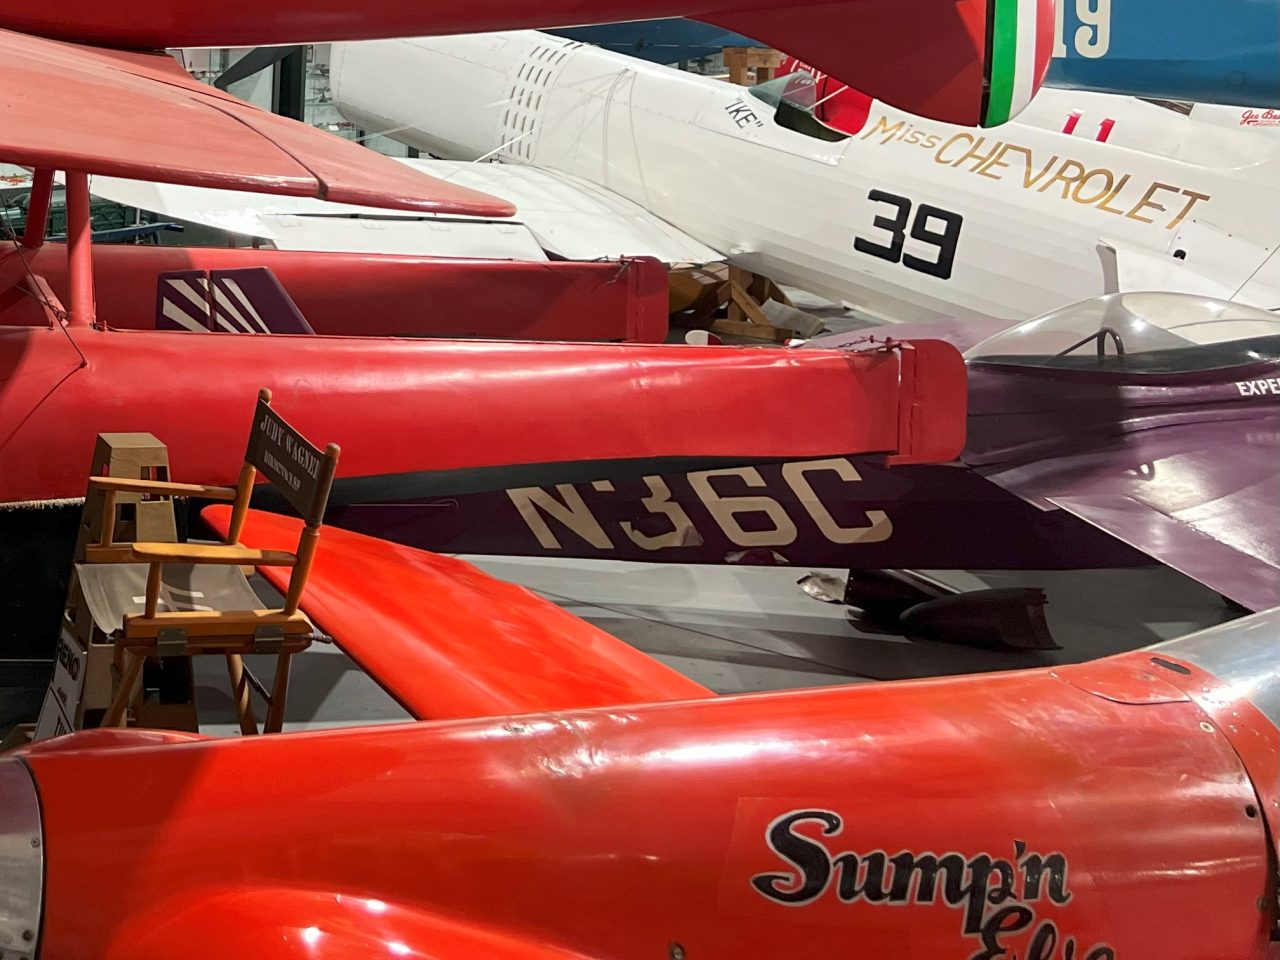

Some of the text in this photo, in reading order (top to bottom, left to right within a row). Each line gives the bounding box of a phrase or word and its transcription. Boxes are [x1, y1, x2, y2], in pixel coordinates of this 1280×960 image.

[863, 116, 1211, 230] Miss CHEVROLET
[854, 189, 964, 280] 39
[260, 414, 285, 447] JUDY
[506, 457, 893, 551] N36C
[750, 808, 1073, 937] Sump'n
